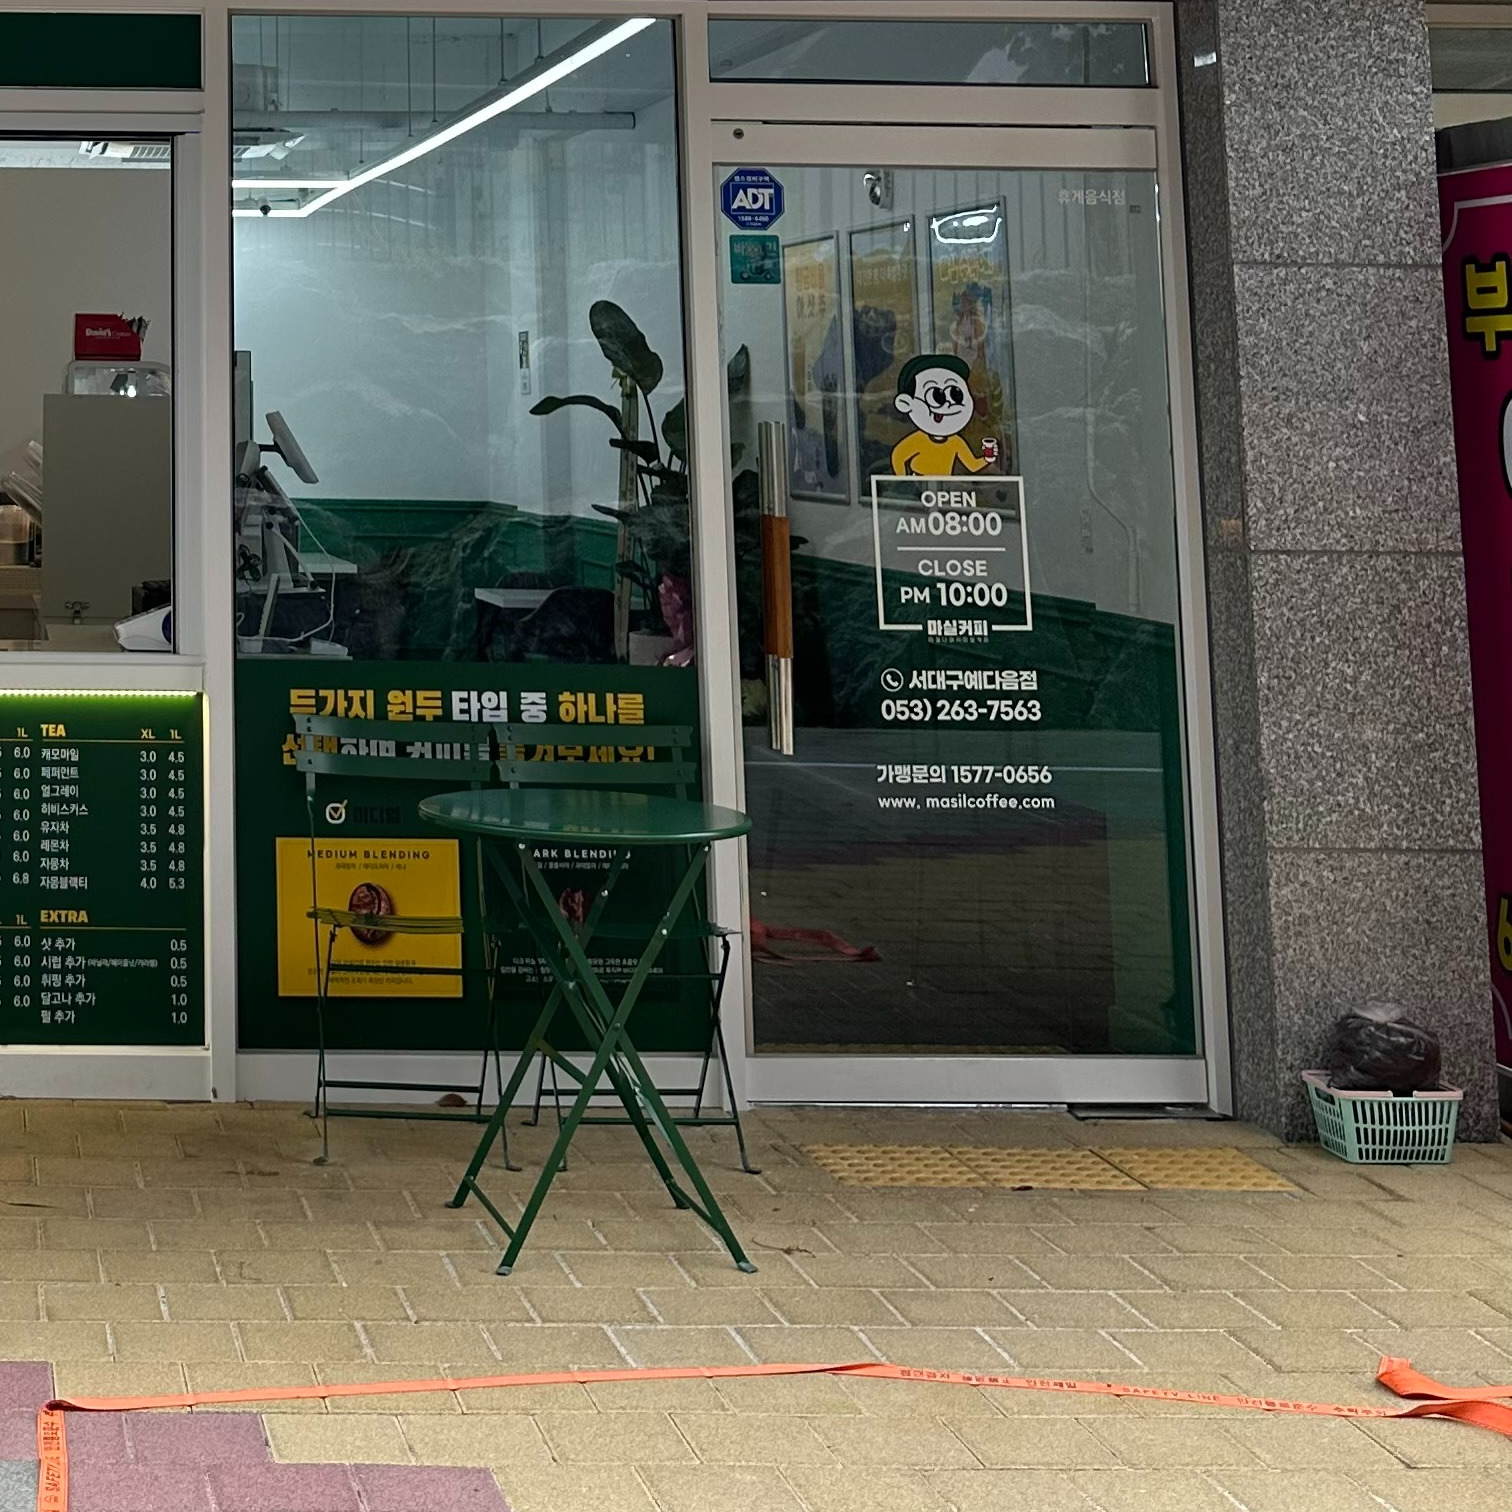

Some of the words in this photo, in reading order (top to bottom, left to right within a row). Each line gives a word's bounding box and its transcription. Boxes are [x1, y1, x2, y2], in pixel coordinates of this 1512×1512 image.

[731, 188, 774, 209] ADT
[1057, 189, 1125, 205] 휴게음식점
[921, 491, 976, 508] OPEN
[896, 517, 926, 534] AM
[927, 511, 1003, 536] 08:00
[918, 559, 987, 577] CLOSE
[900, 586, 930, 604] PM
[936, 582, 1008, 607] 10:00
[927, 620, 988, 636] 마실커피
[909, 670, 1038, 691] 서대구예다음점
[387, 690, 442, 722] 원두
[520, 692, 548, 723] 중
[558, 692, 645, 725] 하나를
[881, 699, 932, 722] 053)
[936, 699, 1042, 721] 263-7563
[41, 725, 66, 736] TEA
[14, 747, 30, 758] 6.0
[41, 749, 79, 761] 캐모마일
[140, 751, 156, 762] 3.0
[877, 765, 946, 783] 가맹문의
[951, 765, 1053, 783] 1577-0656
[41, 785, 79, 798] 얼그레이
[41, 803, 88, 815] 히비스커스
[926, 795, 1055, 810] masilcoffee.com
[307, 849, 358, 860] MEDIUM
[363, 850, 431, 861] BLENDING
[533, 849, 558, 859] ARK
[564, 849, 631, 860] BLENDI
[41, 910, 88, 922] EXTRA
[41, 993, 71, 1005] 달고나
[75, 993, 96, 1005] 추가
